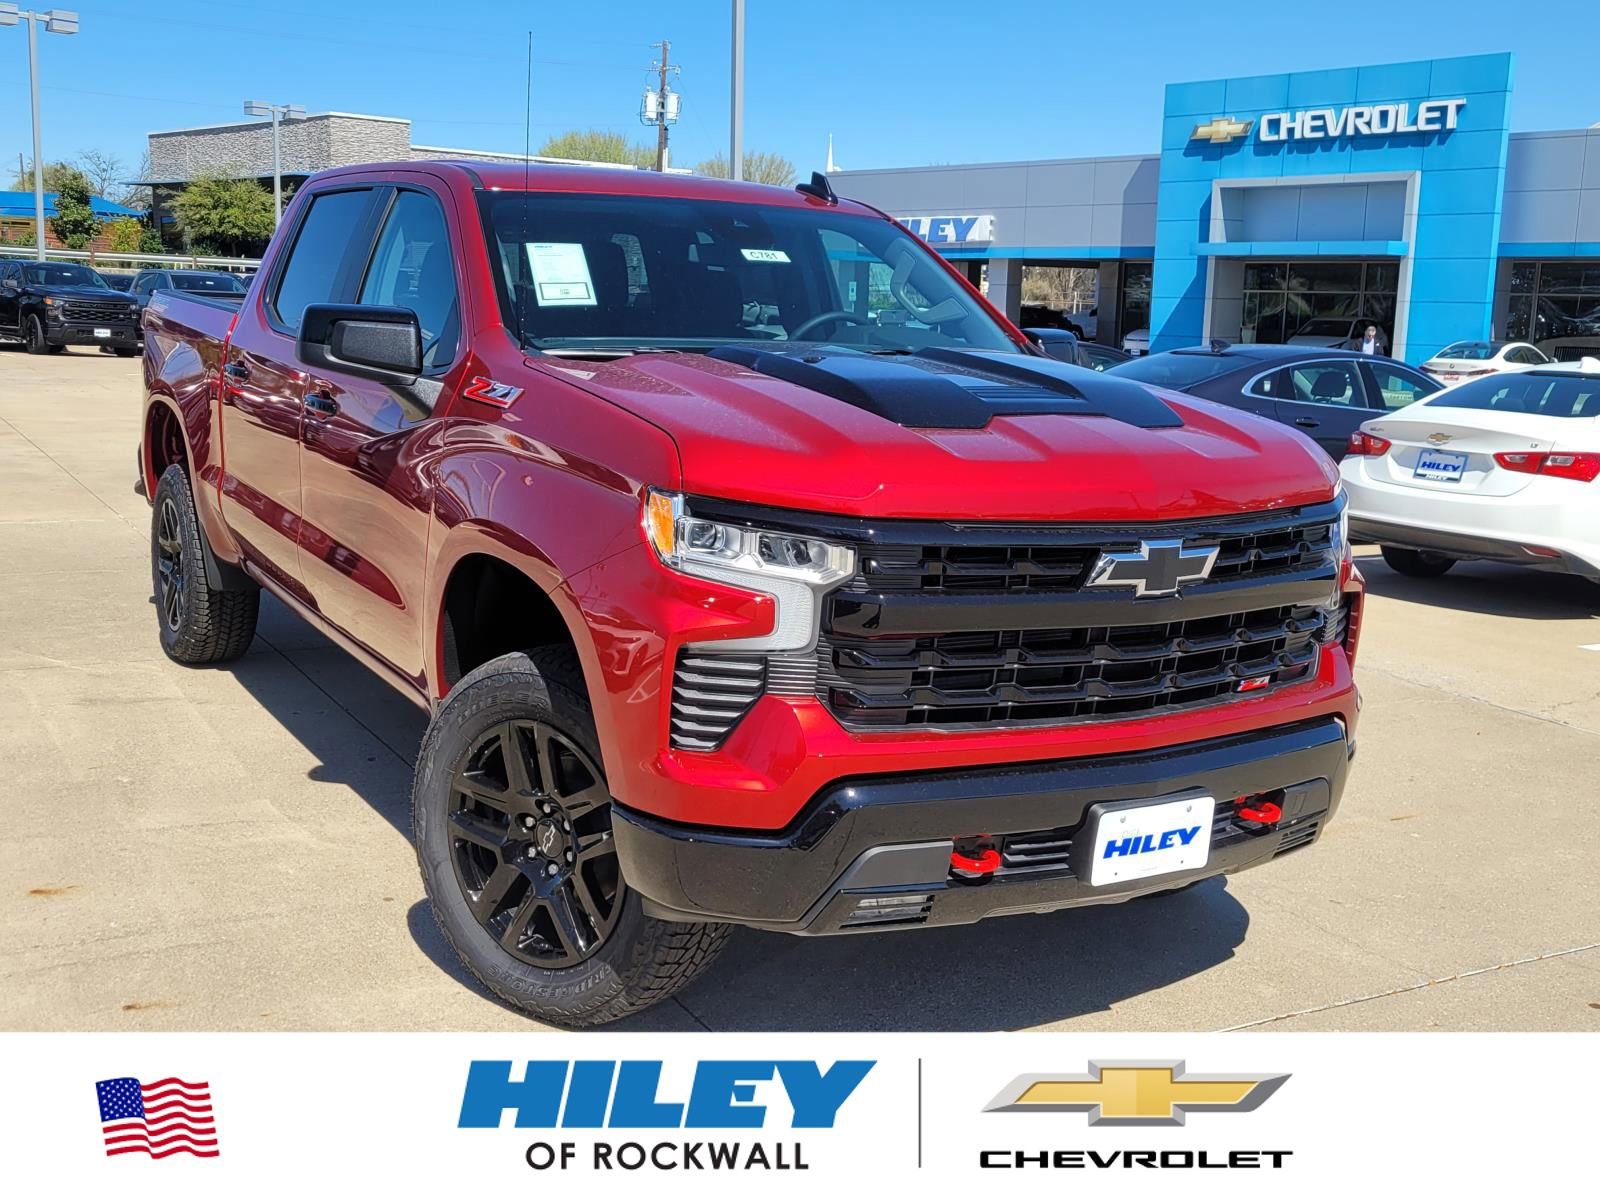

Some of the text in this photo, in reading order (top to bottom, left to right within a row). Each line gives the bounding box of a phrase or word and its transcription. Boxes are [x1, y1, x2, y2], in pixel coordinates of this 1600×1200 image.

[1259, 98, 1467, 142] CHEVROLET
[896, 217, 979, 242] LEY
[464, 375, 525, 409] Z71
[1421, 461, 1461, 472] HILEY
[1103, 825, 1202, 859] HILEY
